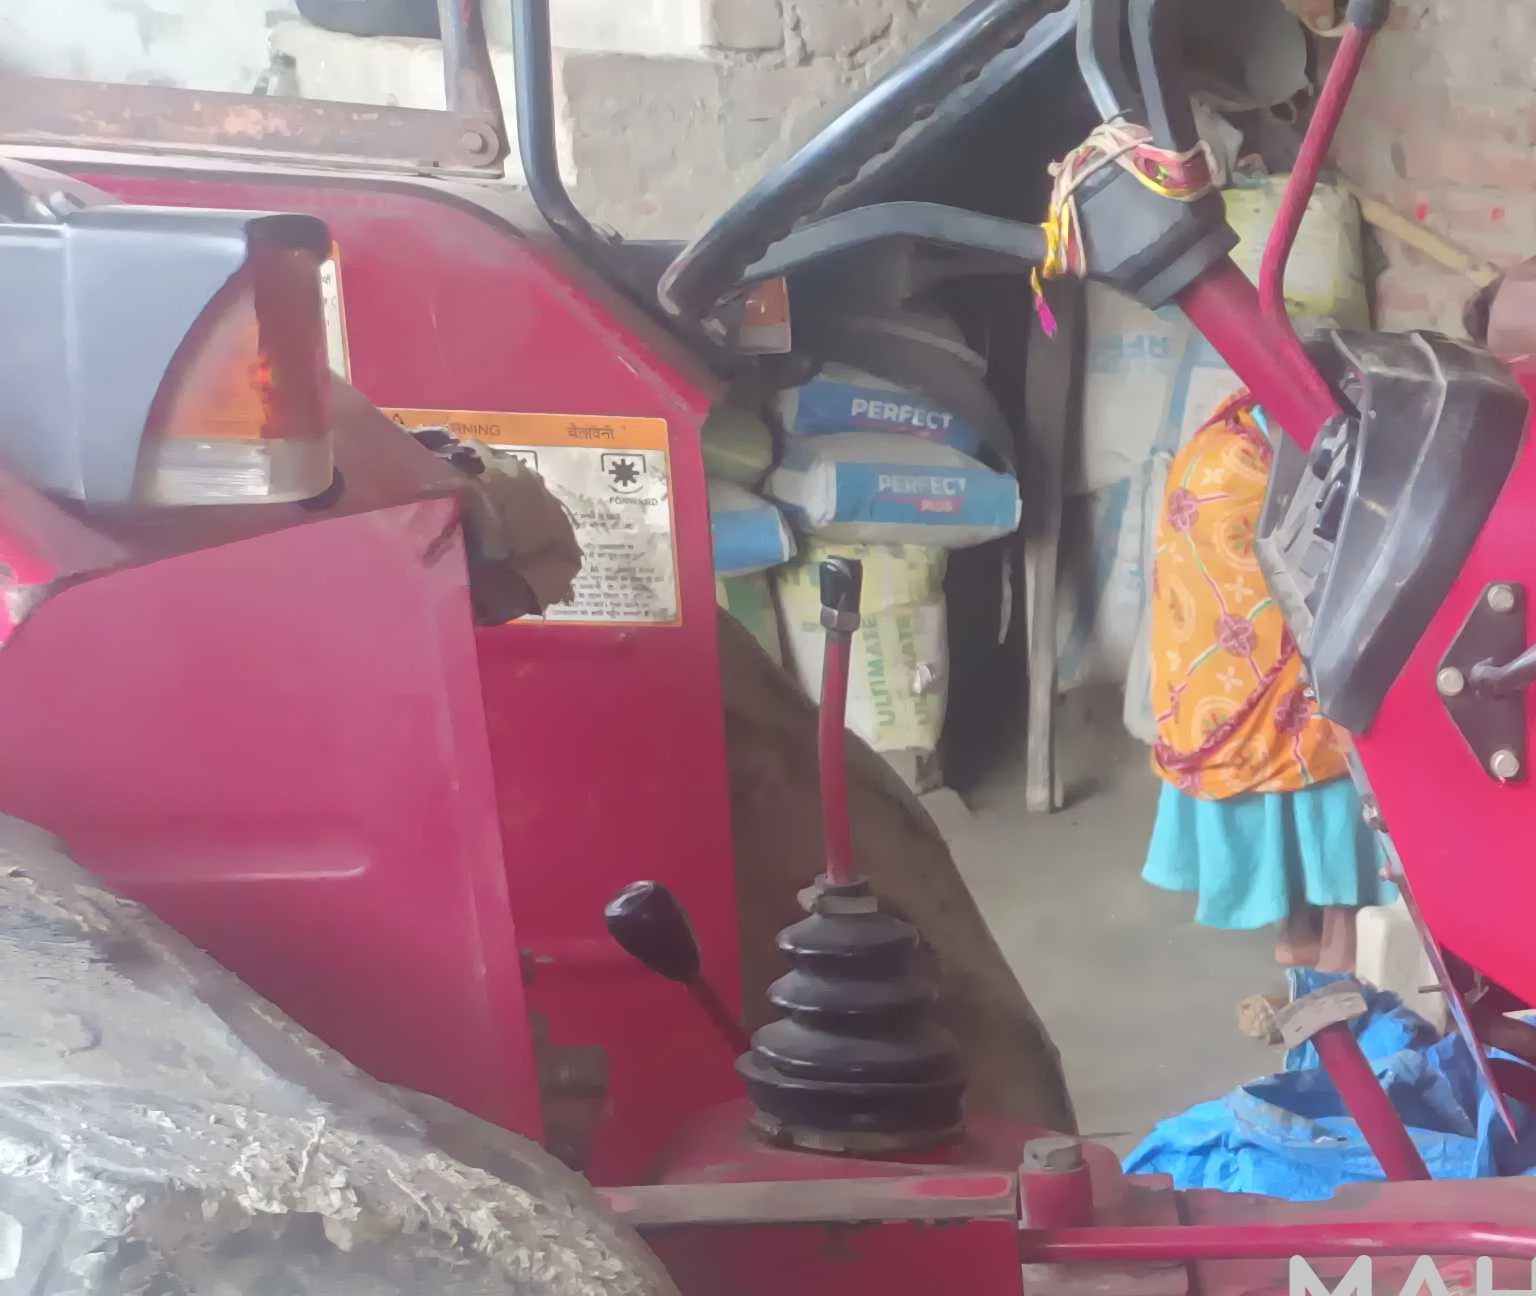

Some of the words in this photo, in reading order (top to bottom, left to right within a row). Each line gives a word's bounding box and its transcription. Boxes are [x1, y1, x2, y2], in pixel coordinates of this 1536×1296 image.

[851, 397, 953, 430] PERFECT
[451, 422, 501, 438] RNING
[878, 473, 967, 496] PERFECT
